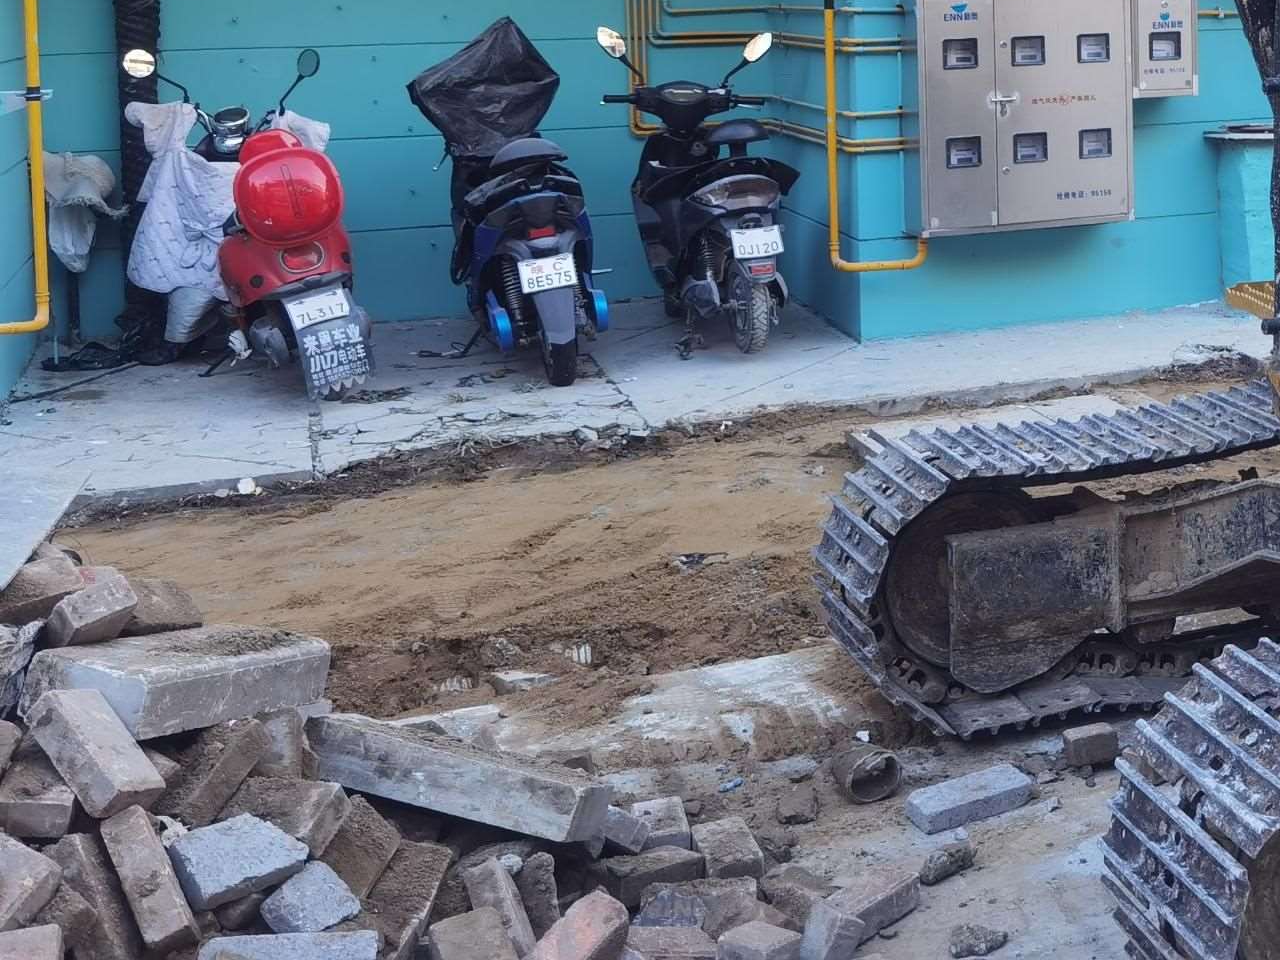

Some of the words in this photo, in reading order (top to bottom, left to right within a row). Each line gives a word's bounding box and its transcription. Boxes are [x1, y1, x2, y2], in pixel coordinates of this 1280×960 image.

[552, 261, 563, 272] C
[527, 270, 573, 290] 8E575
[296, 302, 346, 325] 7L317
